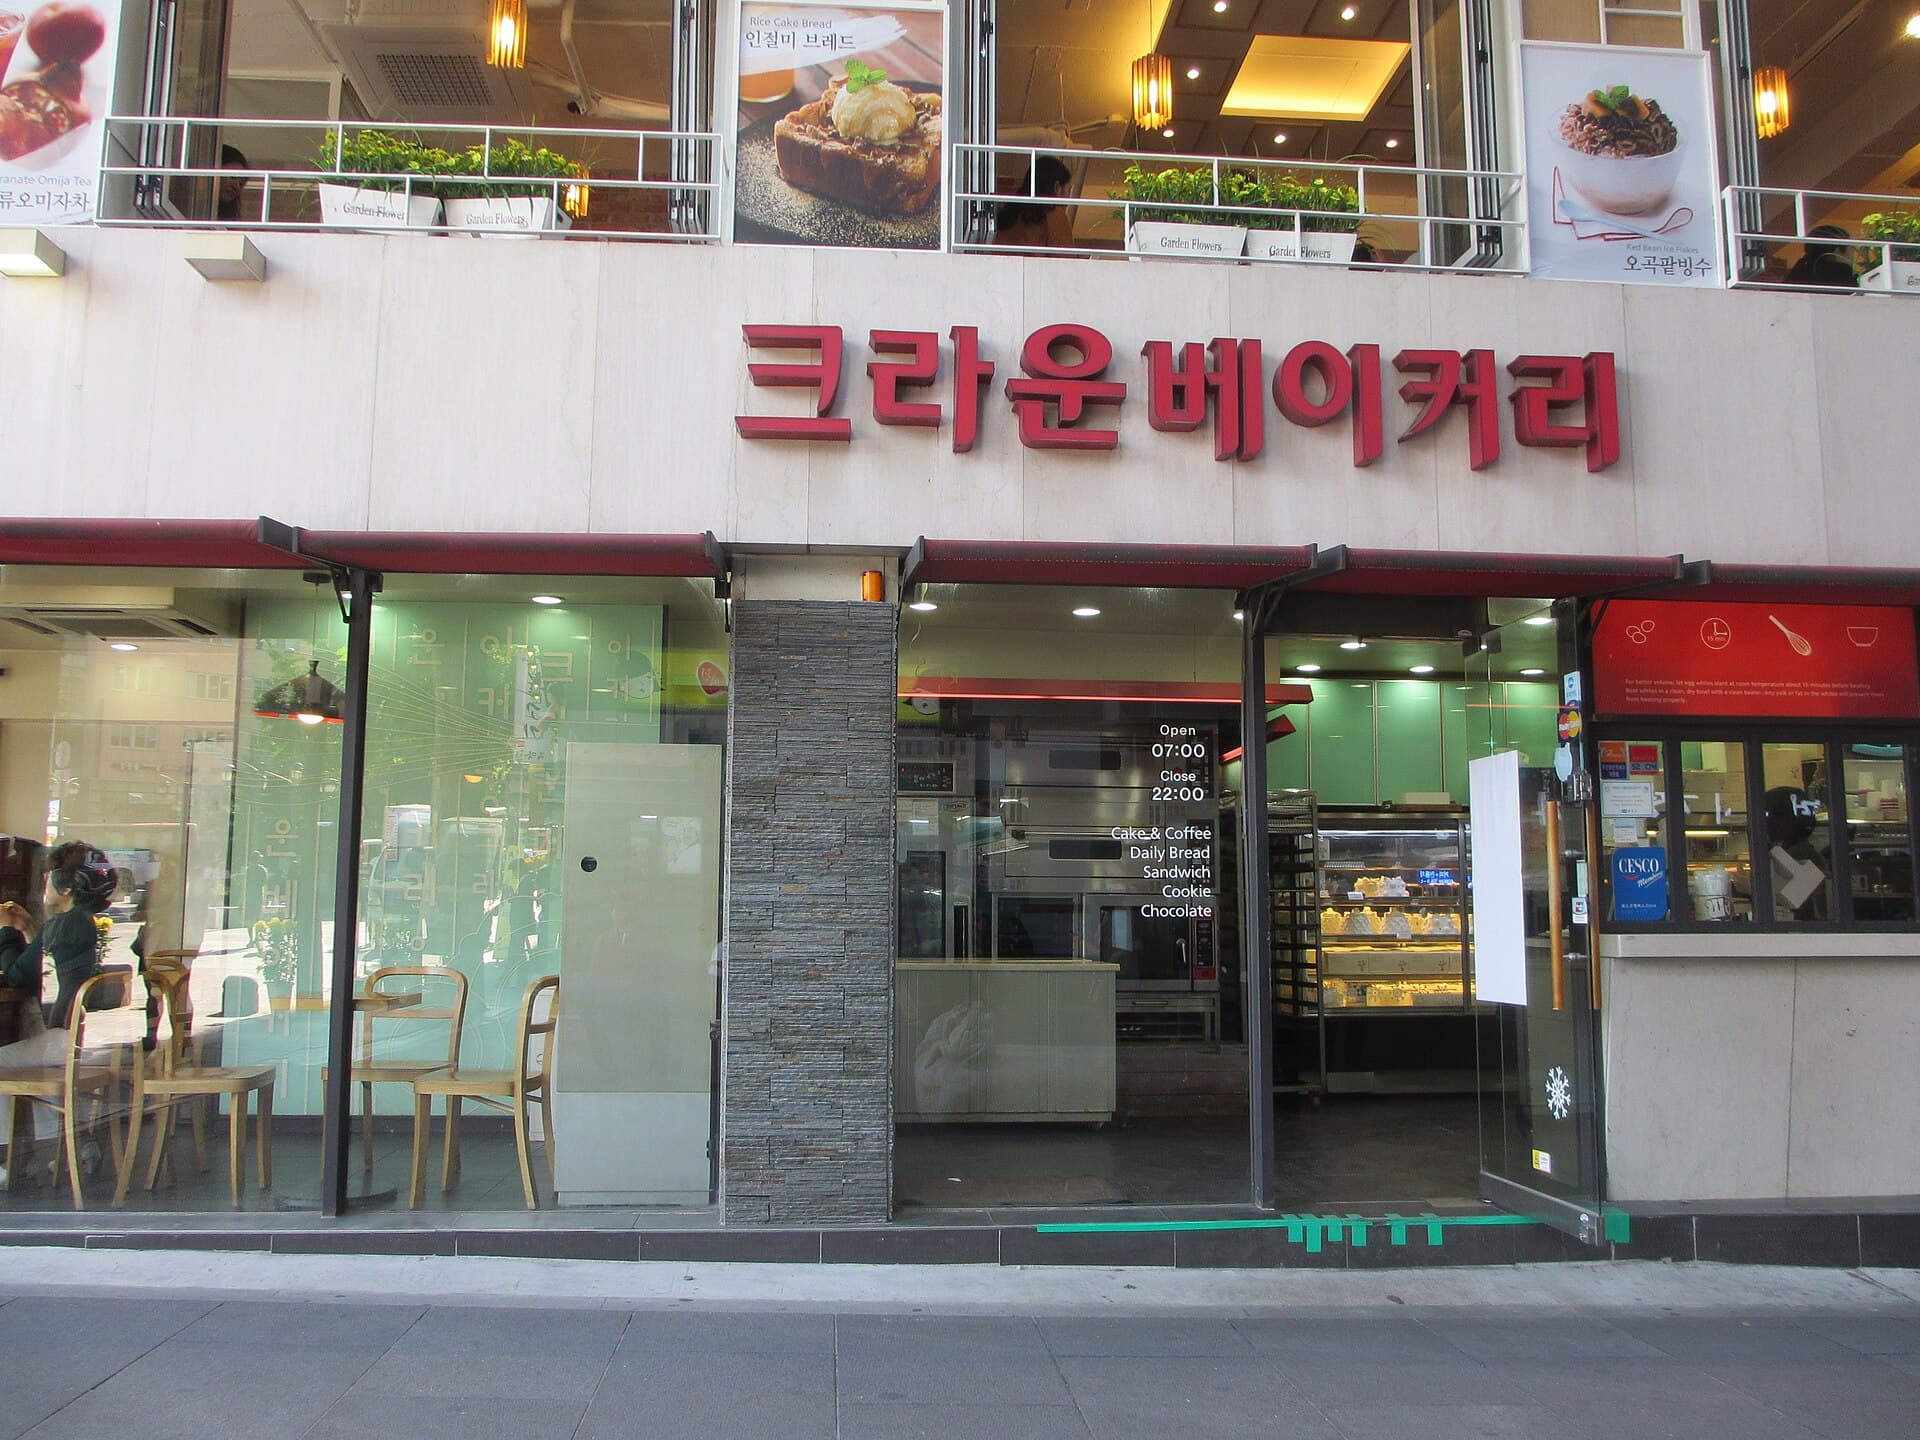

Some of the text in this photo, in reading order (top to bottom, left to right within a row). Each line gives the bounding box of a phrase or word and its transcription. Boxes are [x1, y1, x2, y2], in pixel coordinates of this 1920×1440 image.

[750, 16, 832, 28] Rice Cake Bread
[746, 30, 856, 52] 인절미 브레드
[38, 175, 70, 188] Omija
[73, 176, 92, 187] Tea
[343, 202, 405, 220] Garden Flower
[466, 213, 526, 226] Garden Flowers
[1160, 236, 1222, 252] Garden Flowers
[1624, 255, 1712, 278] 오곡팥빙수
[735, 322, 1621, 473] 크라운베이커리
[1160, 724, 1196, 738] Open
[1152, 744, 1205, 758] 07:00
[1160, 770, 1196, 782] Close
[1152, 787, 1204, 801] 22:00
[1111, 825, 1212, 840] Cake & Coffee
[1130, 845, 1210, 862] Daily Bread
[1143, 864, 1211, 879] Sandwich
[1618, 857, 1660, 873] CESCO
[1162, 884, 1212, 898] Cookie
[1140, 904, 1212, 918] Chocolate
